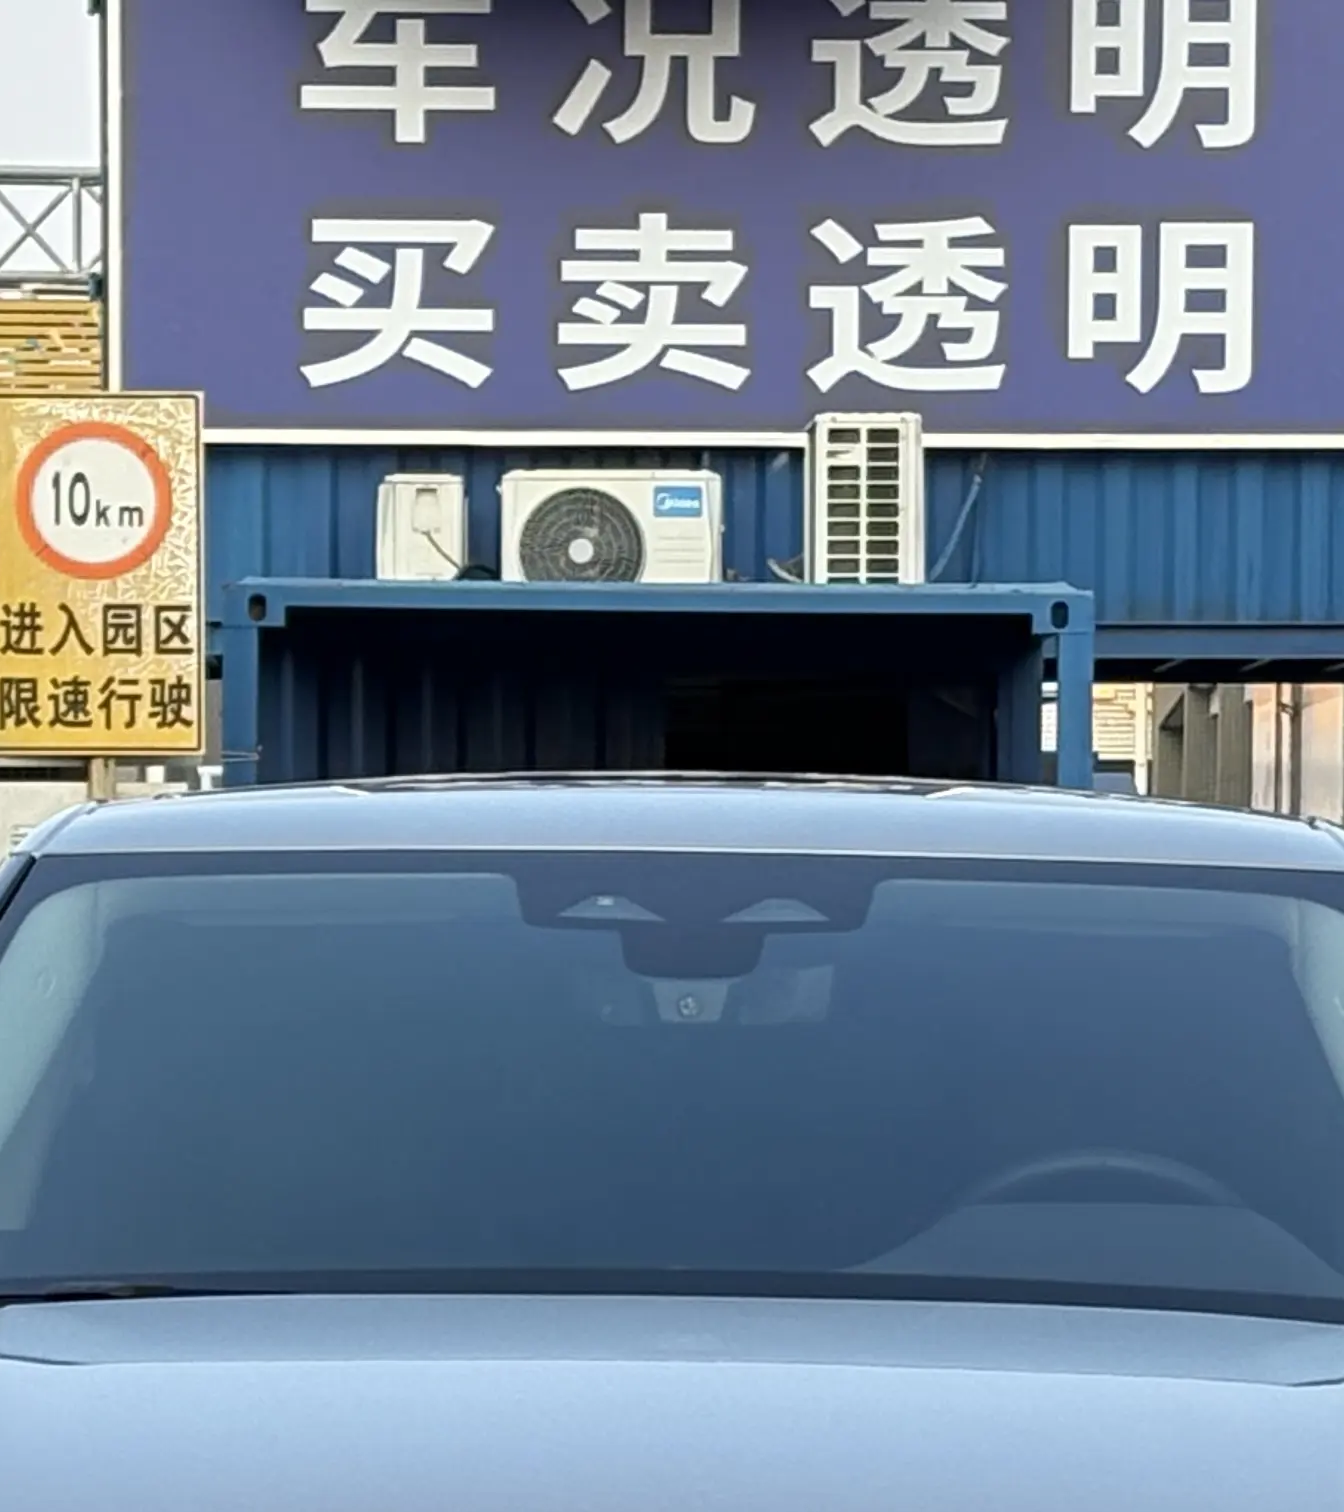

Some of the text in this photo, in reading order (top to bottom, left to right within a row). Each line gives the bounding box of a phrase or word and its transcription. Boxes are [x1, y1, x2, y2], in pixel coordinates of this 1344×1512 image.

[298, 0, 1258, 149] 车况透明
[298, 212, 1256, 395] 买卖透明
[50, 471, 145, 529] 10km
[0, 603, 196, 657] 进入园区
